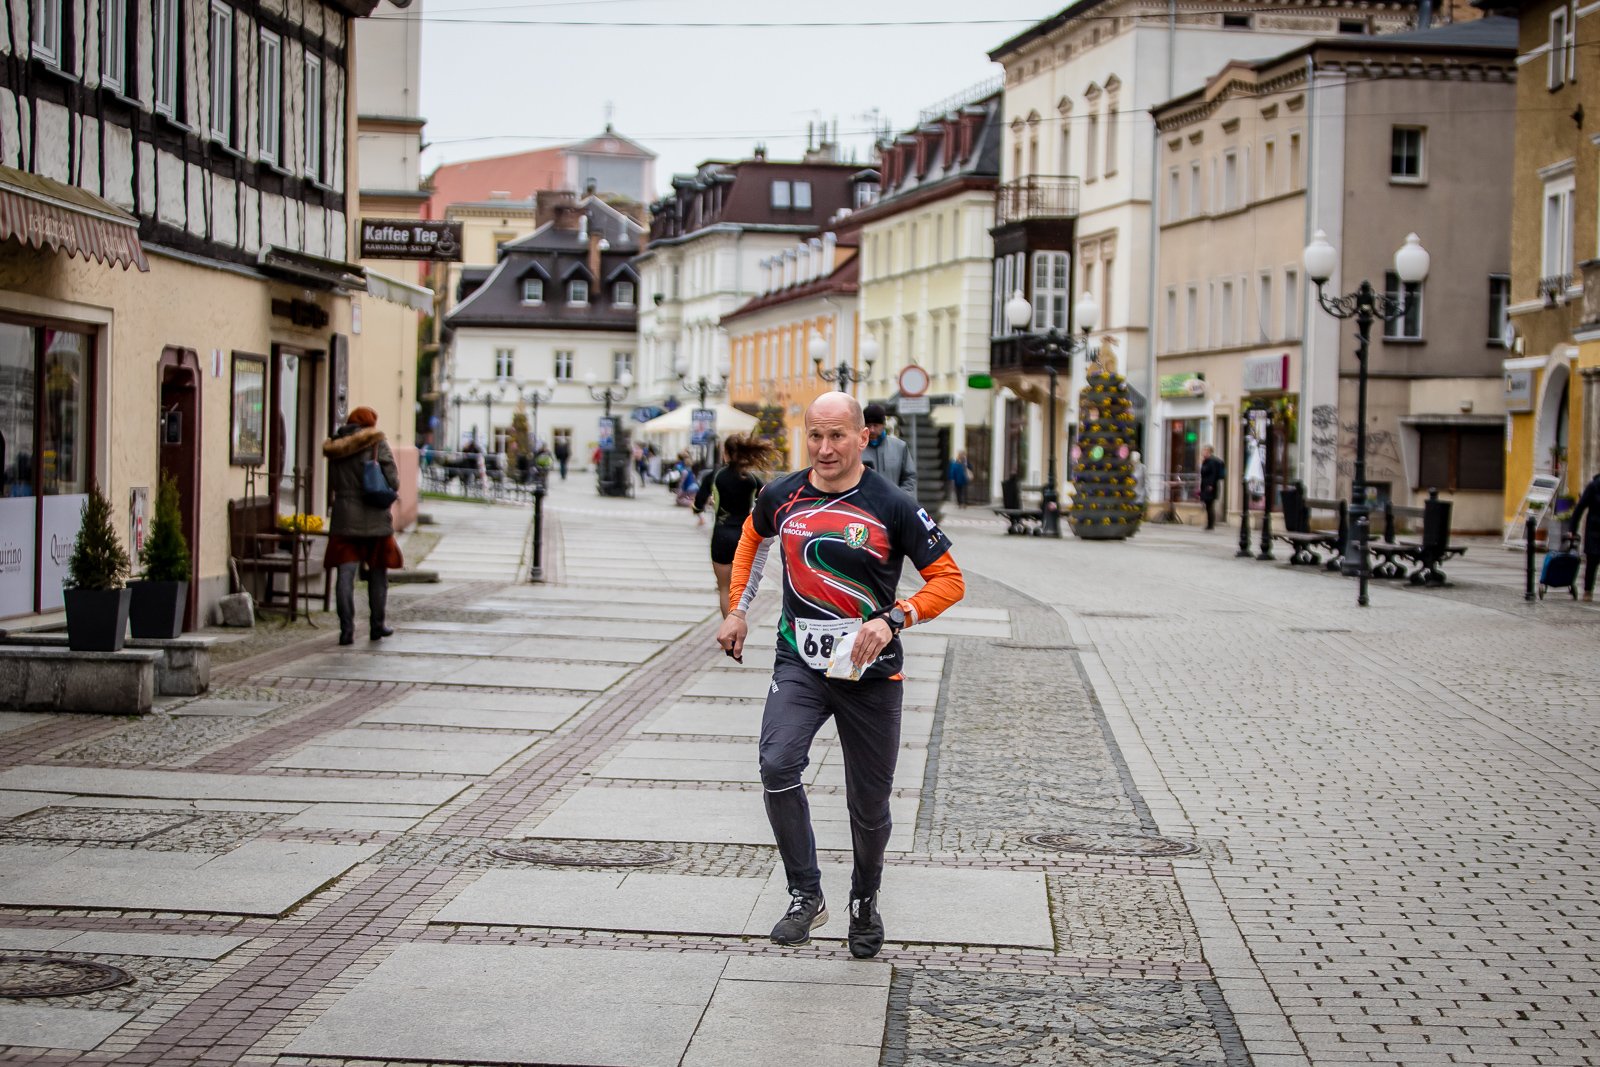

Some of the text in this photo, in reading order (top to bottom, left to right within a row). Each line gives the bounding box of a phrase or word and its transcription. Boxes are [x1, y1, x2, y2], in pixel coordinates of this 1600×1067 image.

[365, 225, 438, 242] Kaffee Tee
[789, 520, 807, 529] ŚLĄSK
[783, 528, 813, 537] WROCŁAW
[0, 541, 22, 573] uirino
